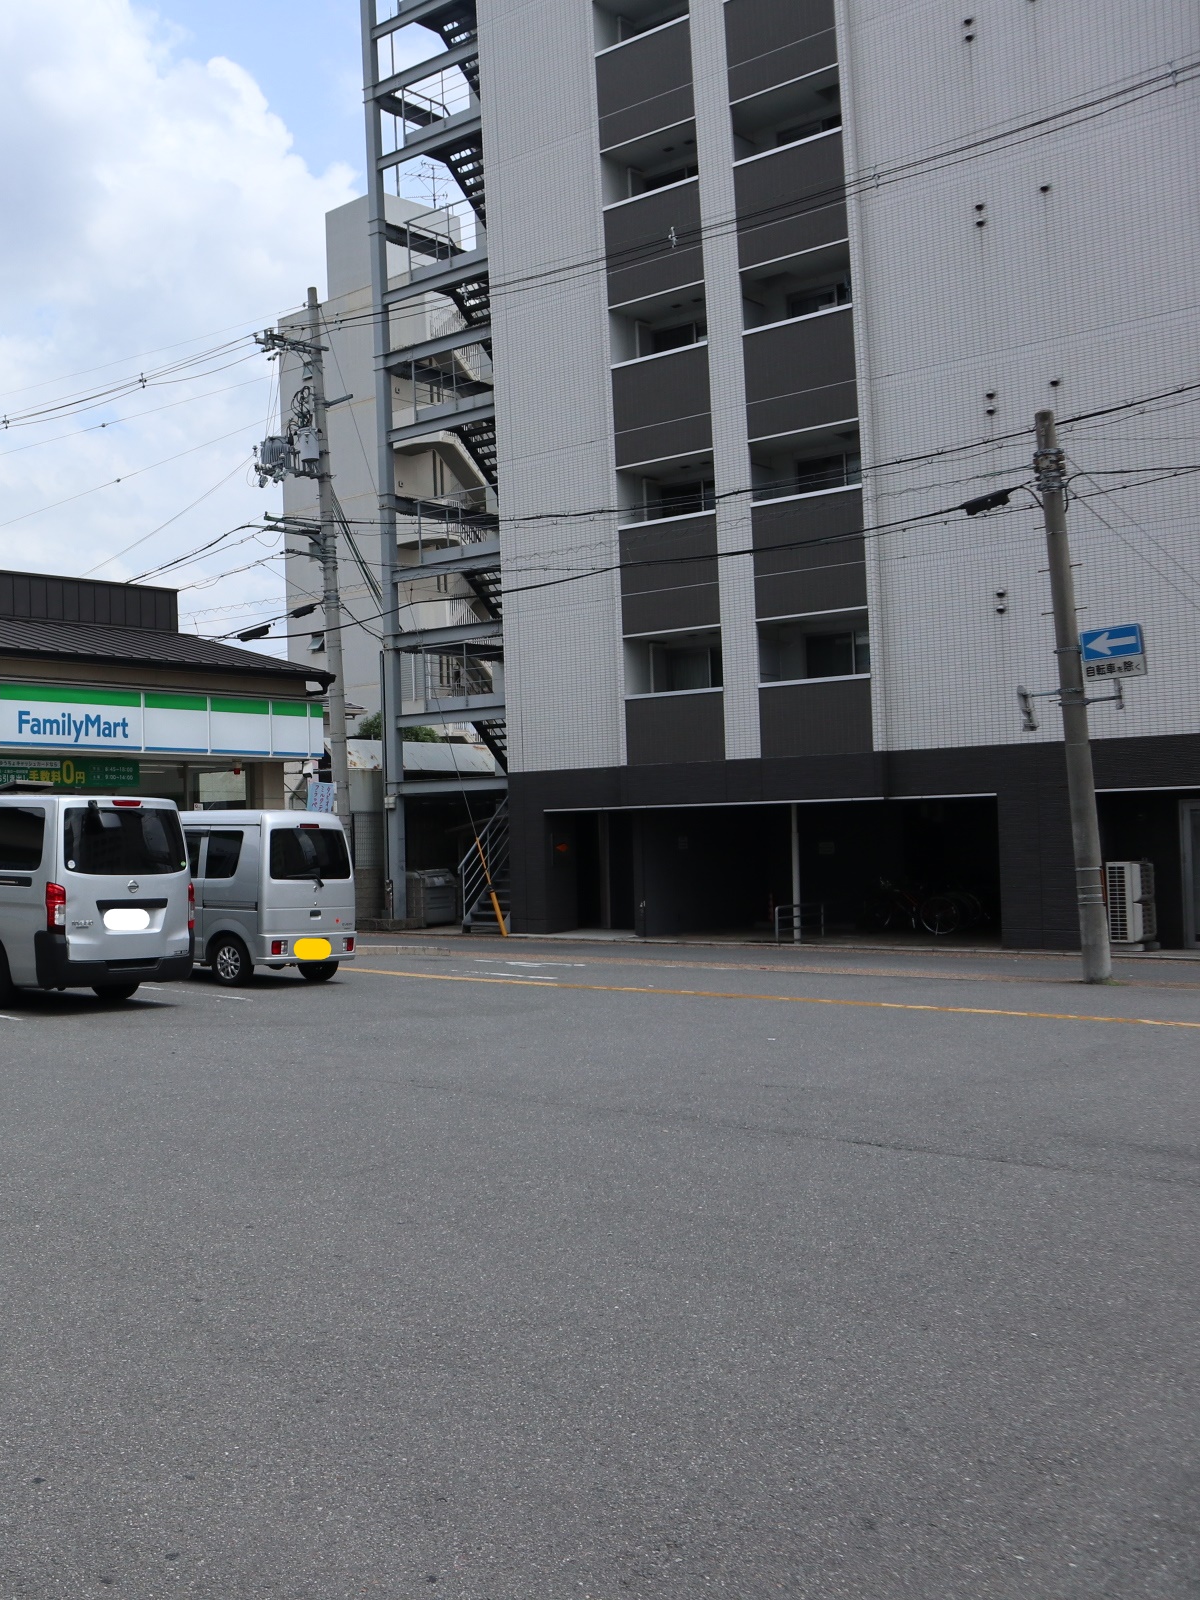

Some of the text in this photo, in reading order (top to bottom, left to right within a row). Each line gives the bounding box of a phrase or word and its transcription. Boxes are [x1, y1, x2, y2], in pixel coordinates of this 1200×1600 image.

[1086, 661, 1140, 677] 自転車を除く
[18, 710, 128, 742] FamilyMart
